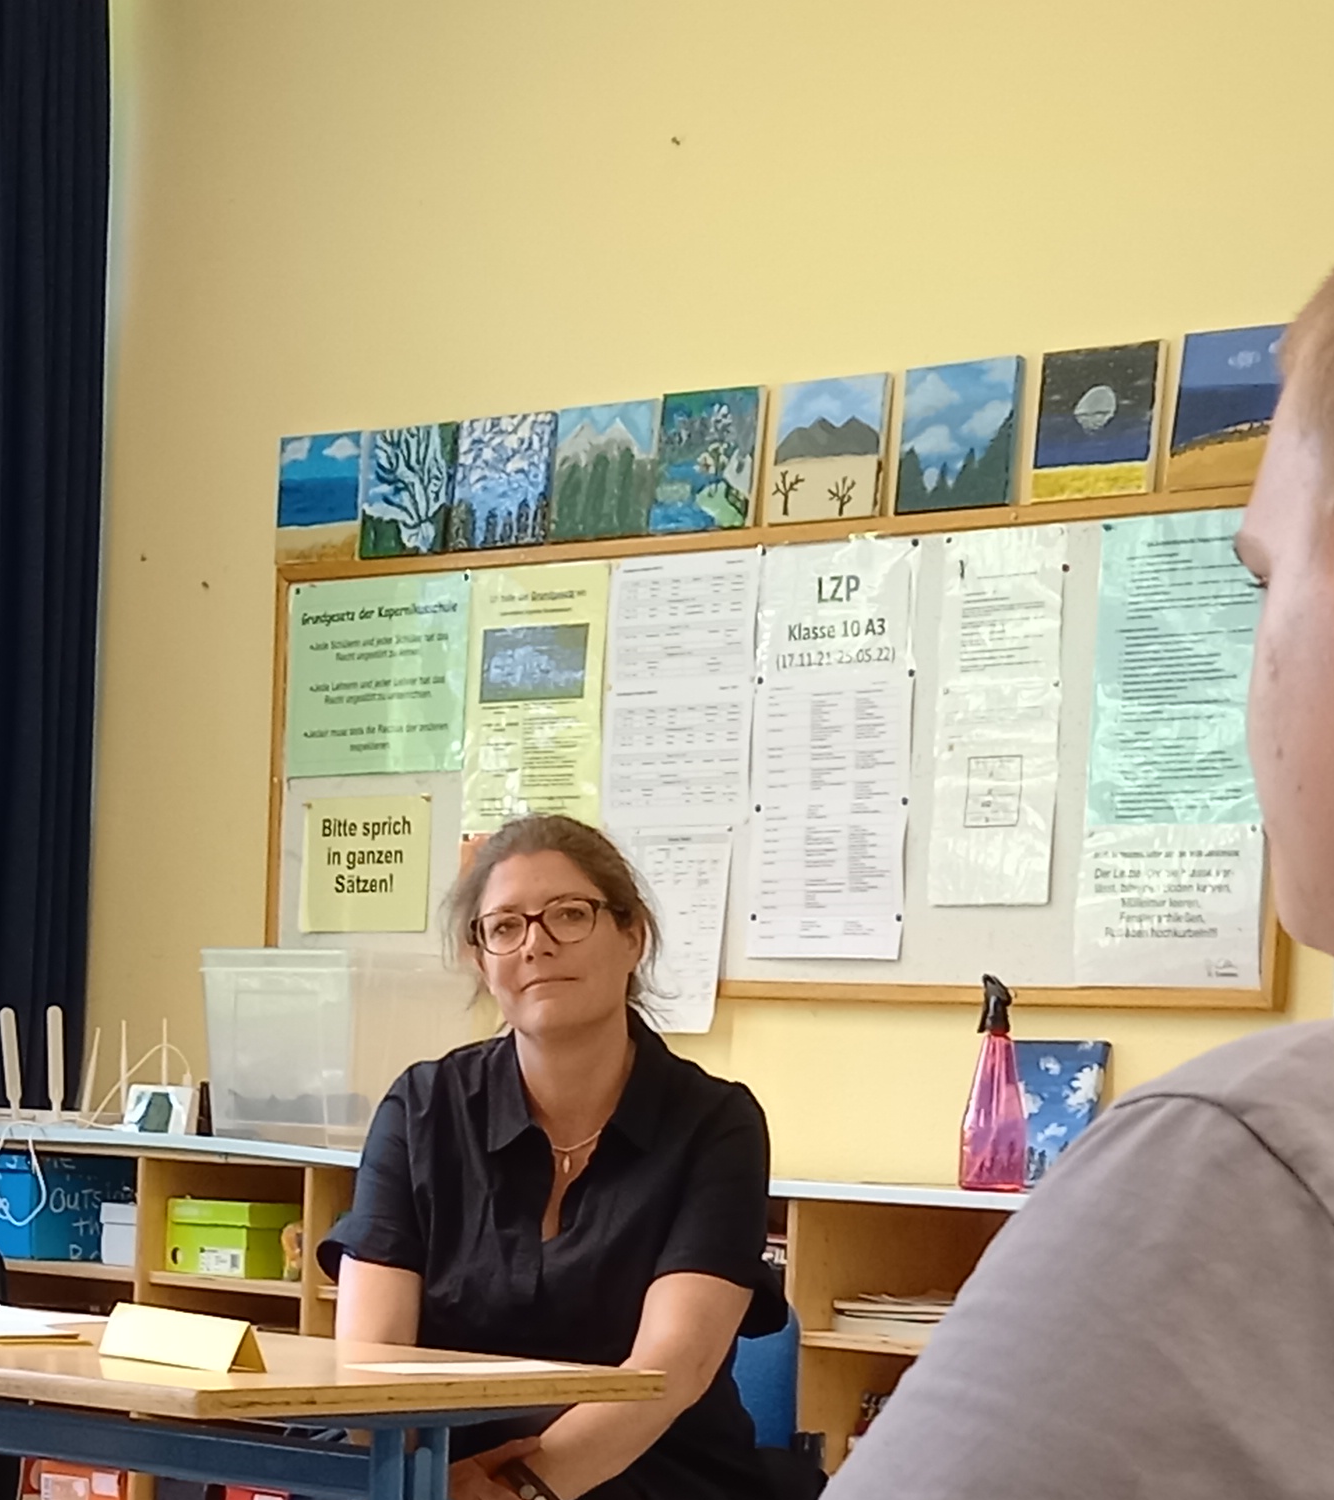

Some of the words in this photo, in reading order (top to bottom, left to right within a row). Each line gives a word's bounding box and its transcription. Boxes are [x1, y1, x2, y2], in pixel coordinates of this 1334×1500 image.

[817, 574, 861, 604] LZP
[358, 606, 375, 621] der
[787, 622, 836, 642] Klasse
[841, 619, 861, 638] 10
[865, 617, 887, 637] A3
[321, 817, 358, 838] Bitte
[362, 815, 412, 841] sprich
[327, 847, 342, 866] in
[346, 849, 404, 870] ganzen
[334, 873, 394, 894] Sätzen!
